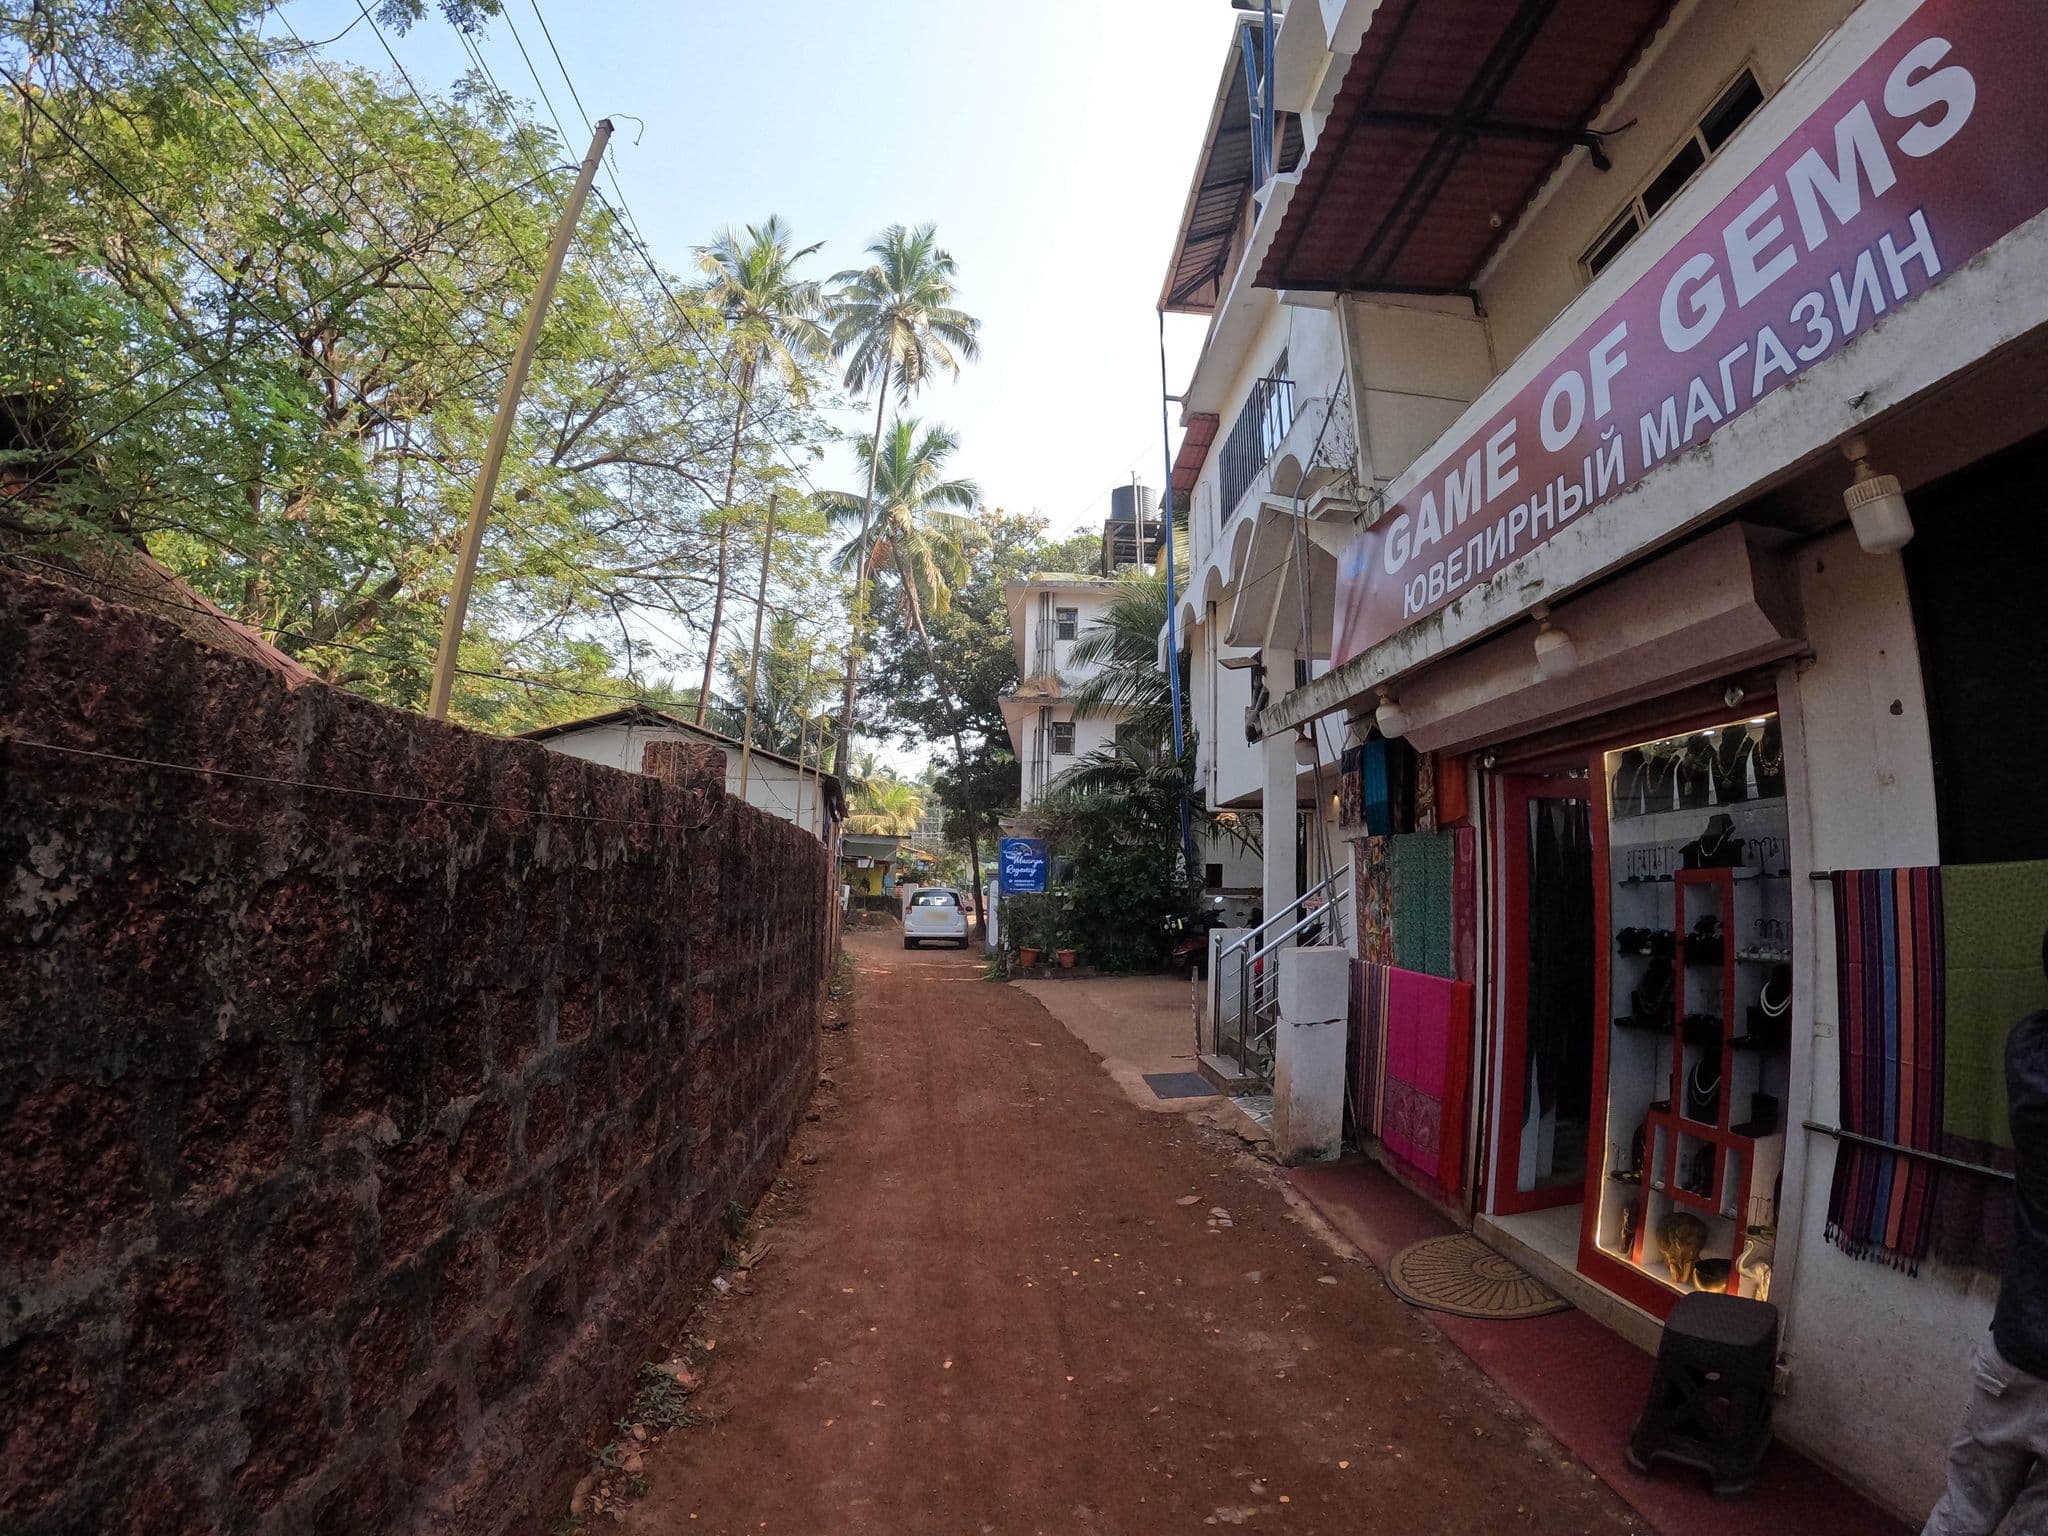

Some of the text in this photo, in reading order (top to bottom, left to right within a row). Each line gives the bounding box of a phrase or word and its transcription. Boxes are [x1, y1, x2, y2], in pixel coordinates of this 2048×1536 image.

[1384, 37, 1976, 575] GAME OF GEMS
[1403, 209, 1942, 619] ЮВЕЛИРНЫЙ МАГАЗИН
